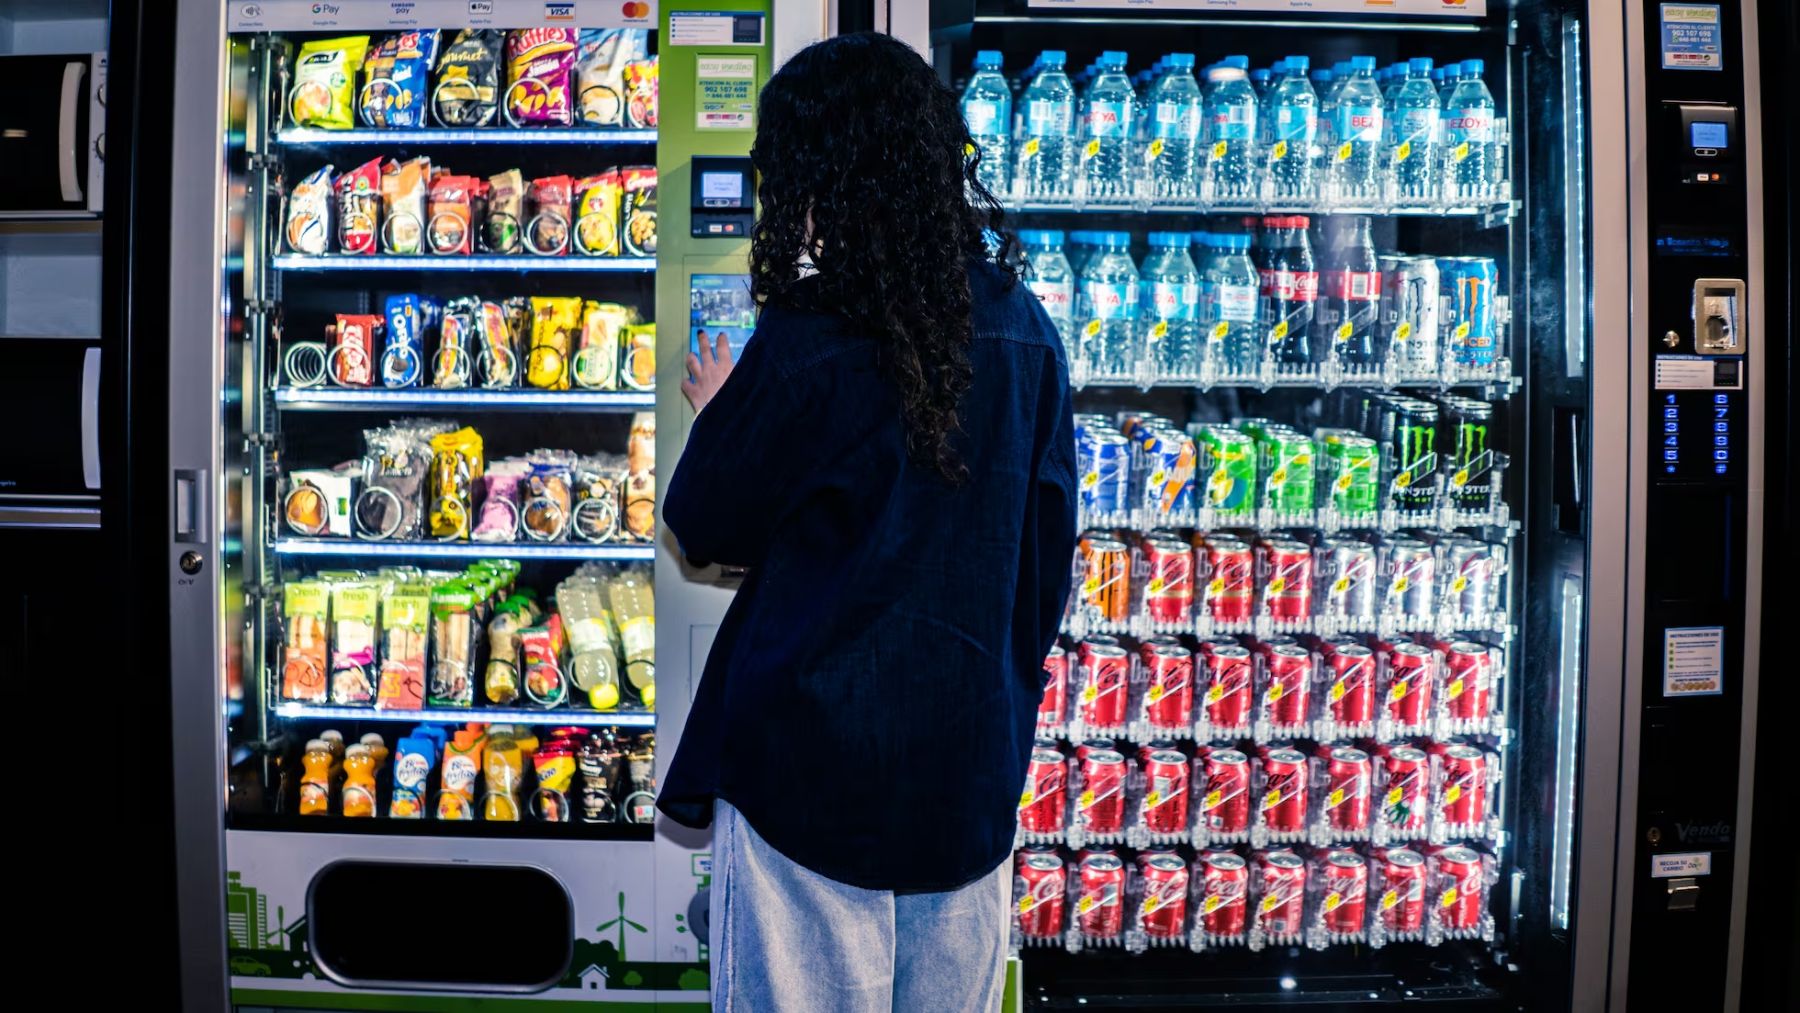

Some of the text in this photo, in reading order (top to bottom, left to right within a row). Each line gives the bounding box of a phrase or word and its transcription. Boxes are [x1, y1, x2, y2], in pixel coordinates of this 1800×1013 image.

[323, 4, 340, 15] Pay
[395, 7, 410, 15] pay
[477, 3, 491, 11] Pay
[550, 8, 570, 16] VISA
[1666, 394, 1676, 404] 1
[1714, 394, 1728, 404] 6
[1664, 408, 1678, 418] 2
[1714, 408, 1728, 418] 7
[1664, 422, 1678, 432] 3
[1714, 422, 1728, 432] 8
[1664, 436, 1678, 446] 4
[1714, 436, 1728, 446] 9
[1664, 450, 1678, 460] 5
[1714, 450, 1728, 460] 0
[342, 590, 368, 600] fresh
[1675, 821, 1730, 842] Vendo
